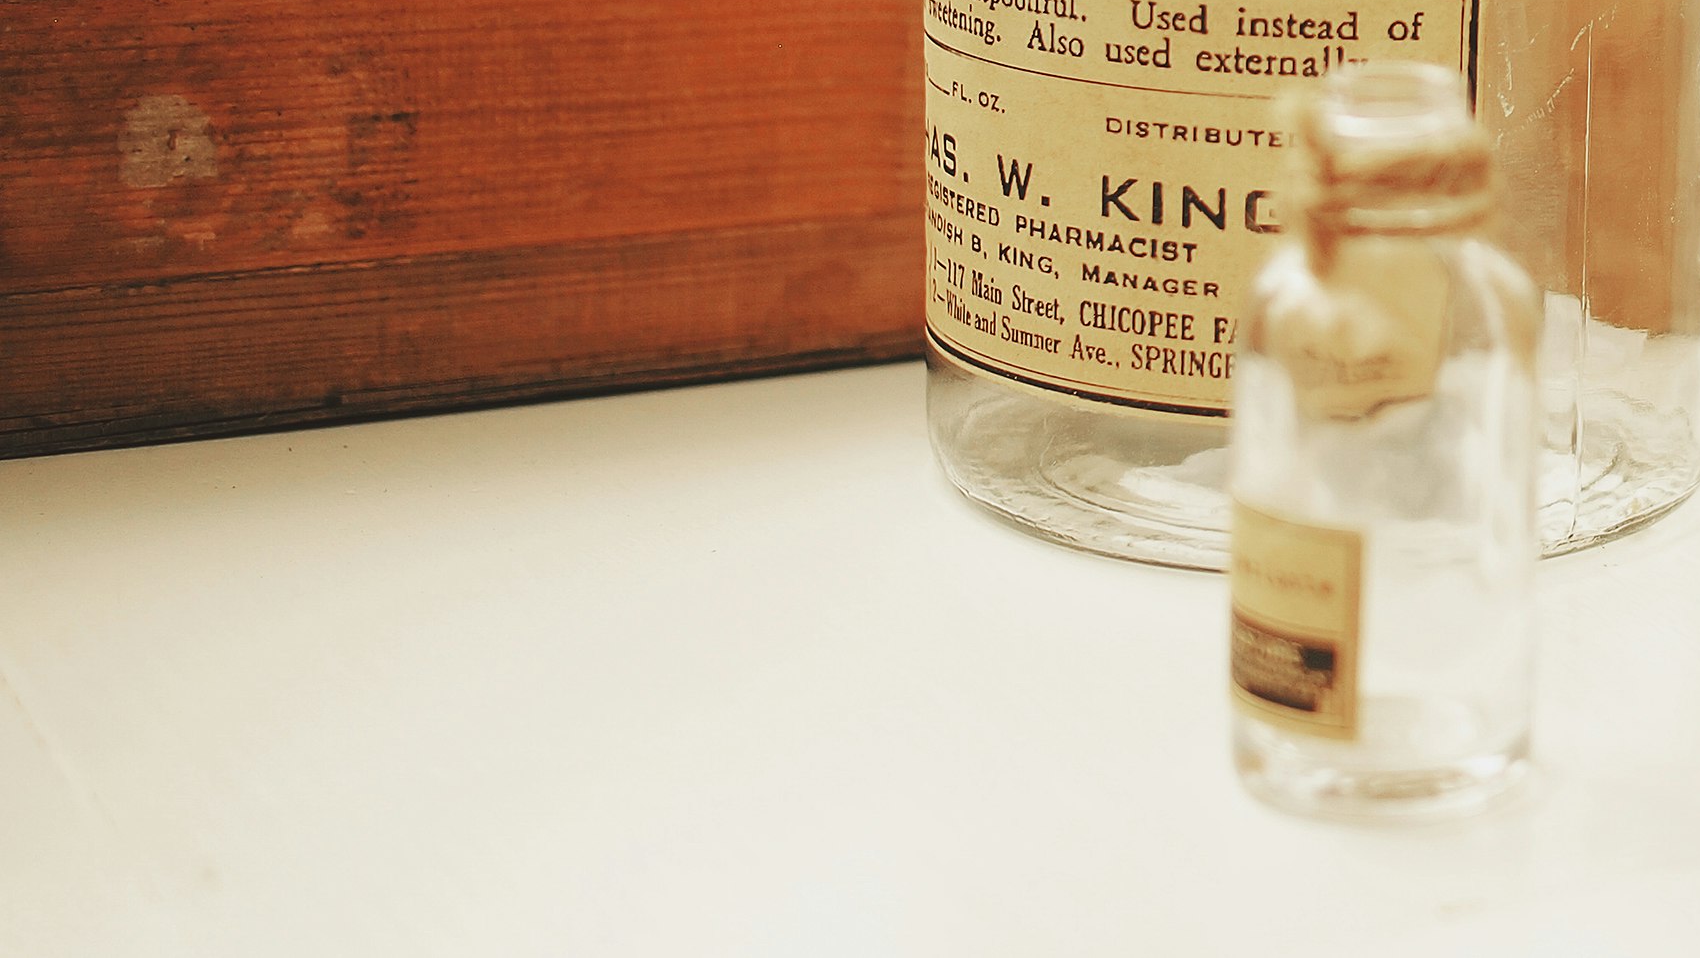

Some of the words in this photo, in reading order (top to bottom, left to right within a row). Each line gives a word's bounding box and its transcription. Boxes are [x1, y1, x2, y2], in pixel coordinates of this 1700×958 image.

[1130, 0, 1208, 36] Used
[1236, 6, 1359, 41] instead
[1387, 12, 1424, 41] of
[1027, 20, 1084, 58] Also
[1105, 40, 1171, 69] used
[1196, 45, 1369, 79] externall
[952, 81, 972, 104] FL.
[978, 91, 1005, 114] OZ.
[1105, 117, 1294, 149] DISTRIBUTE
[997, 154, 1050, 207] W.
[1016, 215, 1197, 264] PHARMACIST
[999, 243, 1059, 280] KING,
[1082, 263, 1219, 298] MANAGER
[972, 270, 1001, 305] Main
[1012, 285, 1065, 325] Street,
[1080, 300, 1195, 341] CHICOPEE
[975, 311, 996, 336] and
[1001, 316, 1061, 354] Sumner
